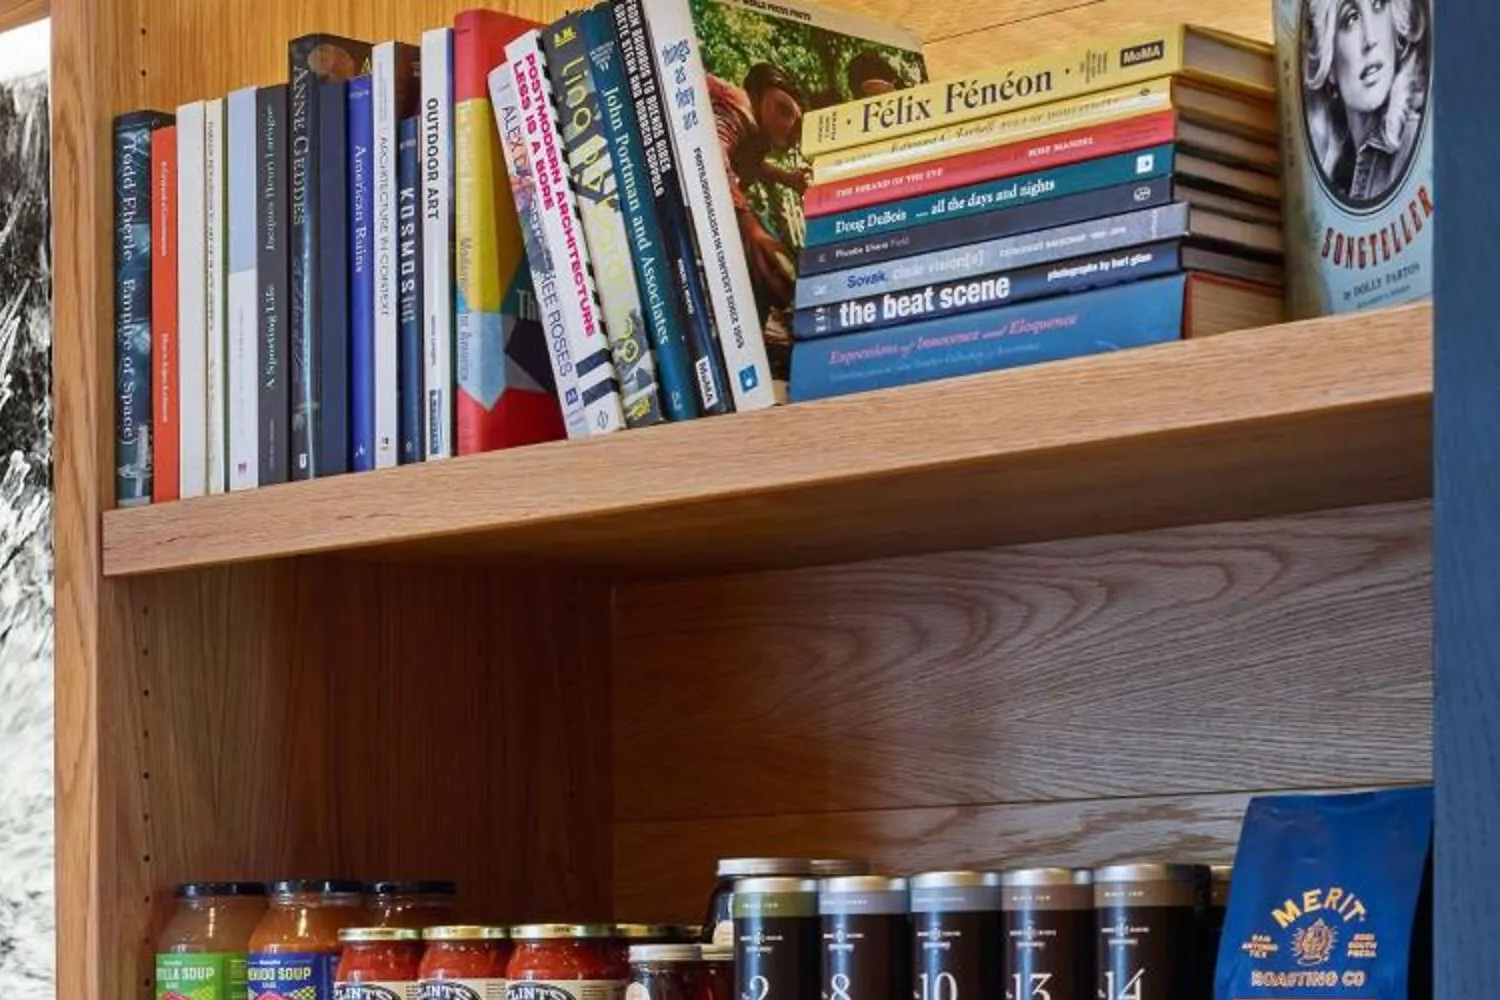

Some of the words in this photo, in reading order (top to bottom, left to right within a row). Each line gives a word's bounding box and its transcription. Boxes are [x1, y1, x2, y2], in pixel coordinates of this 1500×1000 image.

[293, 64, 310, 132] ANNE
[860, 91, 931, 133] Félix
[943, 67, 1052, 114] Fénéon
[121, 141, 137, 192] Todd
[426, 97, 439, 183] OUTDOOR
[513, 60, 531, 111] LESS
[526, 114, 537, 135] IS
[535, 160, 555, 213] BORE
[293, 135, 310, 225] GEDDES
[355, 145, 367, 222] American
[426, 187, 439, 220] ART
[525, 52, 563, 184] POSTMODERN
[555, 191, 596, 338] ARCHITECTURE
[931, 198, 944, 216] all
[946, 195, 965, 212] the
[967, 190, 994, 212] days
[995, 184, 1017, 204] and
[1019, 177, 1055, 200] nights
[121, 195, 137, 262] Eberle
[401, 187, 415, 294] KOSMOS
[502, 105, 521, 151] ALEX
[548, 309, 572, 376] ROSES
[602, 87, 623, 132] John
[614, 133, 641, 216] Portman
[632, 217, 650, 250] and
[641, 252, 669, 346] Associates
[835, 214, 865, 236] Doug
[867, 208, 907, 230] DuBois
[1322, 185, 1433, 270] SONGTELLER
[355, 226, 367, 273] Ruins
[266, 284, 276, 312] Life
[840, 301, 876, 328] the
[883, 286, 934, 323] beat
[940, 276, 1011, 317] scene
[1353, 274, 1382, 297] DOLLY
[121, 279, 137, 354] Empire
[265, 315, 277, 376] Sporting
[1008, 312, 1077, 338] Eloquence
[121, 357, 137, 377] of
[119, 380, 137, 445] Space)
[1271, 887, 1362, 929] MERIT
[181, 967, 215, 981] SOUP
[277, 967, 311, 981] SOUP
[1251, 971, 1338, 988] ROASTING
[1342, 971, 1366, 987] CO
